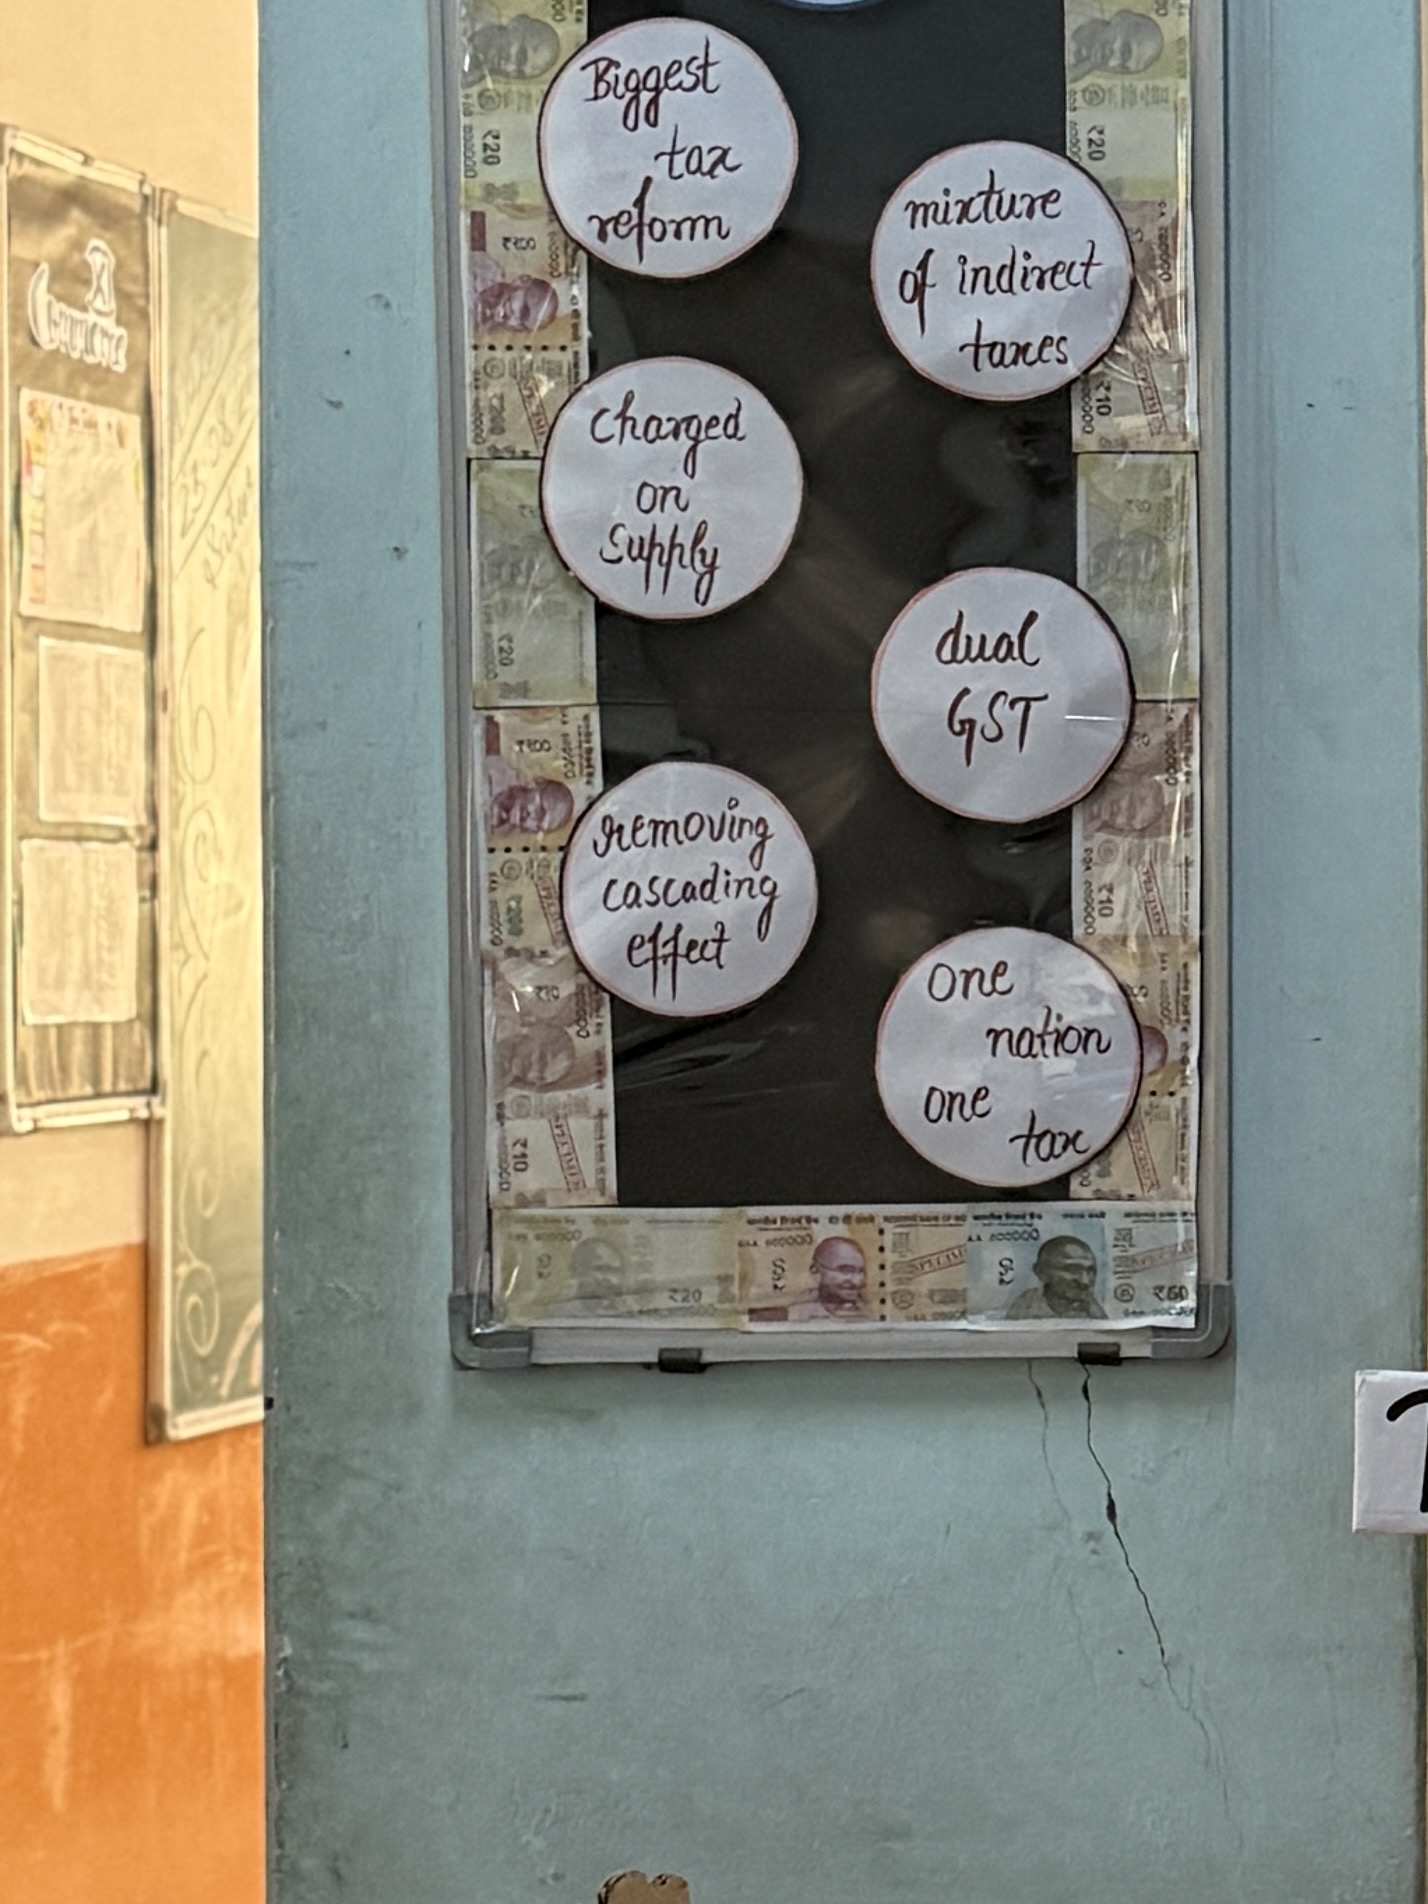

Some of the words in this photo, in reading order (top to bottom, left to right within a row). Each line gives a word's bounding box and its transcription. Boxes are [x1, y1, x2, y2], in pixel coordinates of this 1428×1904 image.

[580, 37, 721, 132] Biggest
[653, 123, 743, 183] tax
[588, 176, 731, 264] reform
[904, 170, 1062, 229] mixture
[899, 246, 935, 333] of
[957, 240, 1103, 296] indirect
[959, 320, 1070, 370] taxes
[636, 481, 690, 515] on
[936, 611, 1041, 667] dual
[946, 693, 1049, 768] GST
[593, 797, 774, 869] removing
[602, 863, 780, 941] cascading
[626, 921, 731, 1000] effect
[986, 1007, 1112, 1059] nation
[1009, 1109, 1091, 1166] tax
